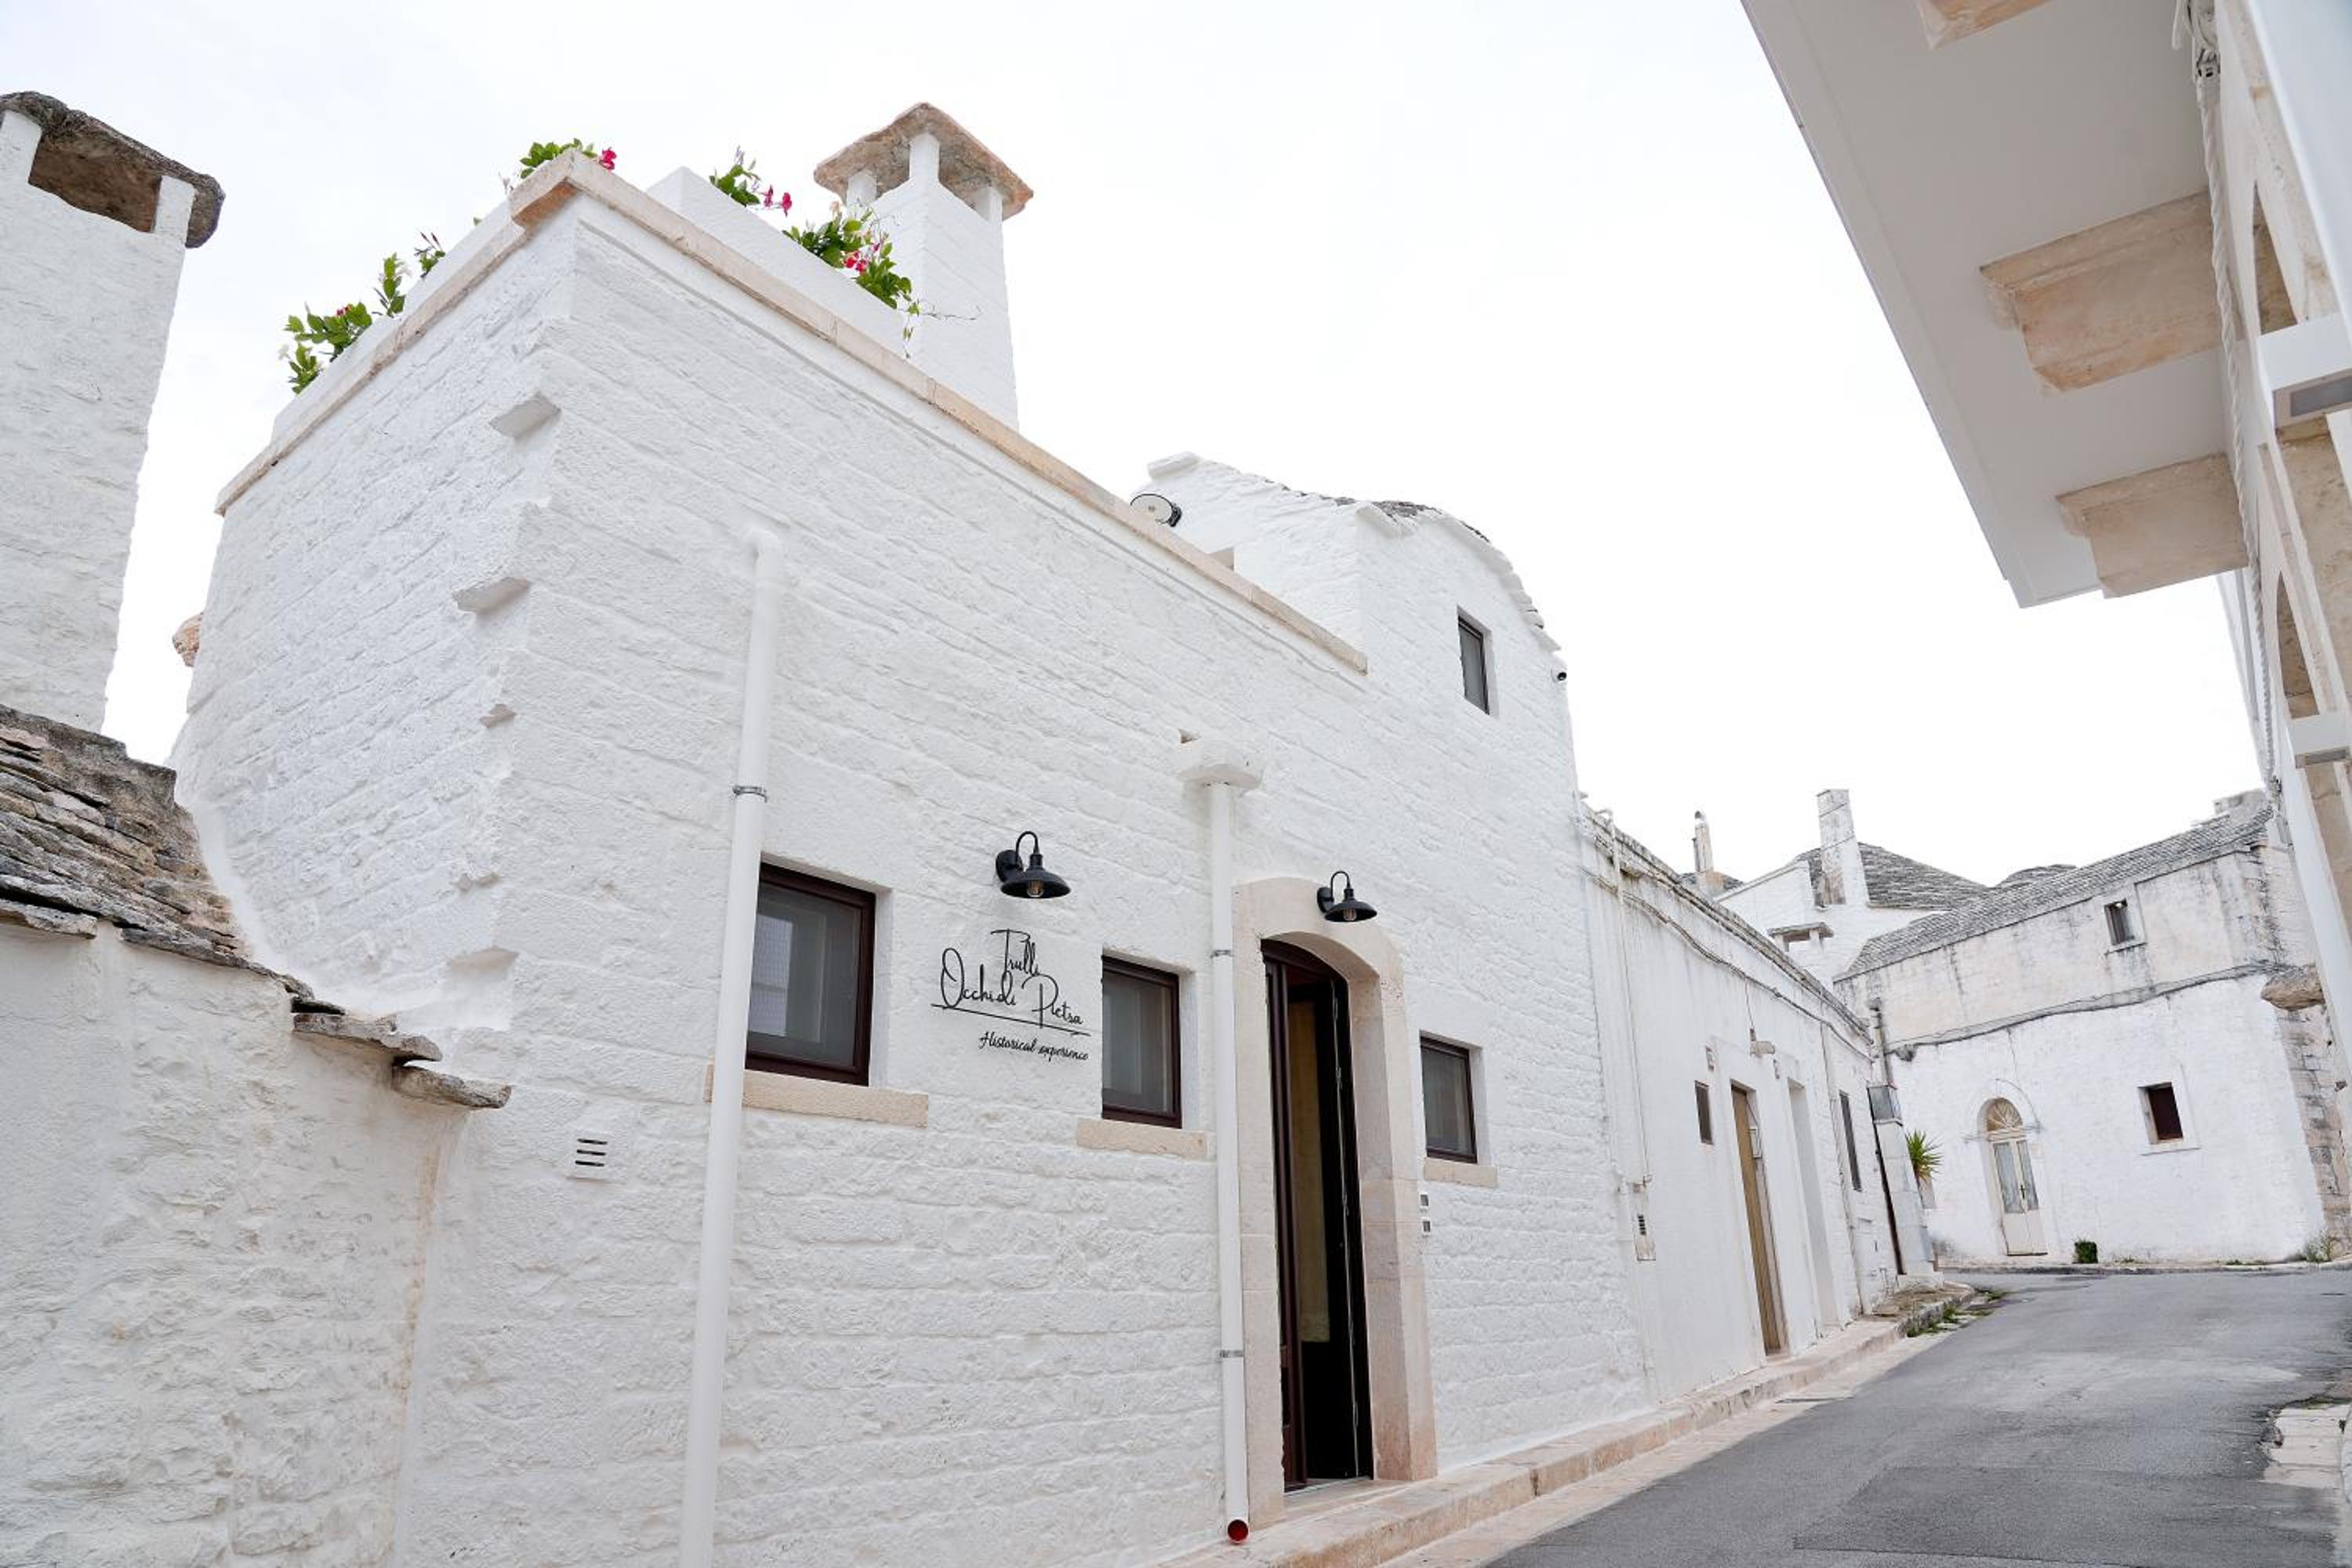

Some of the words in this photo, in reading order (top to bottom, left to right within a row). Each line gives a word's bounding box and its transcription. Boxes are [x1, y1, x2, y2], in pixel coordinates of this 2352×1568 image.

[990, 928, 1040, 976] Trulli
[940, 947, 994, 1007] Occhi
[978, 1031, 1038, 1051] Historical
[1038, 1044, 1090, 1062] experience
